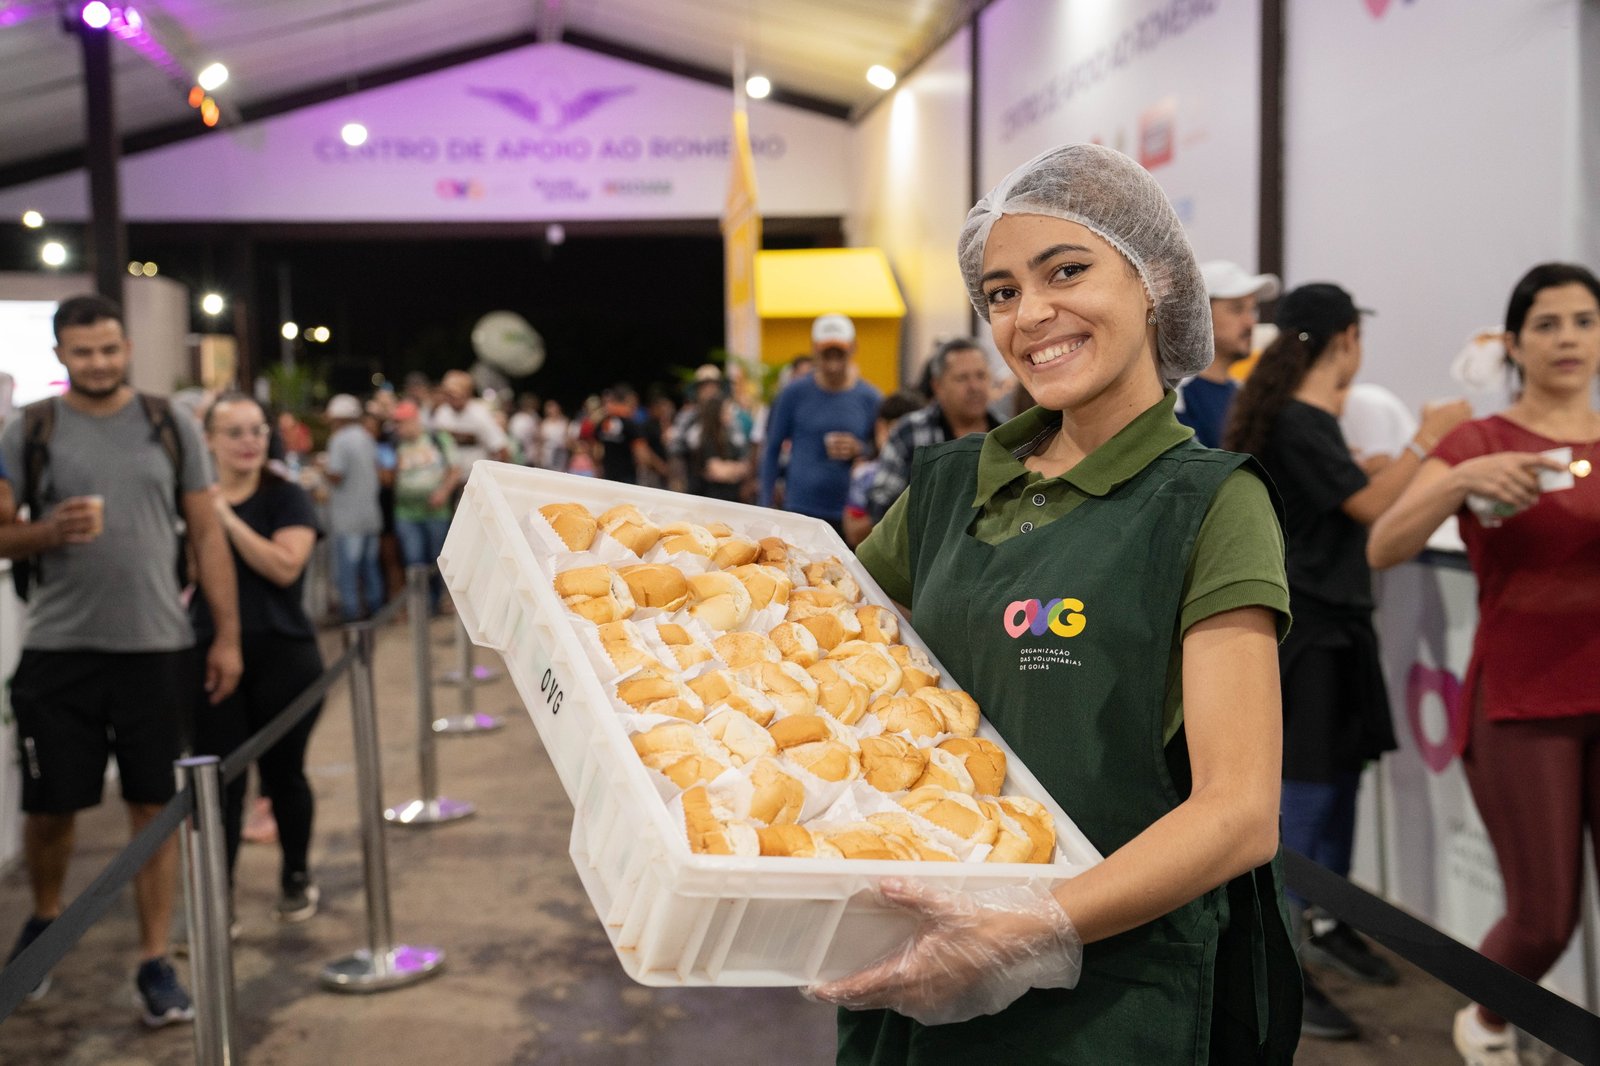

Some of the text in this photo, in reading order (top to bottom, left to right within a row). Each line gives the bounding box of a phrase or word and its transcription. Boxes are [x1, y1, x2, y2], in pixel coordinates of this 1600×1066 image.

[313, 136, 786, 163] CENTRO DE APOIO AO ROMERO
[1003, 598, 1087, 639] OVG
[1020, 648, 1070, 656] ORGANIZAÇÃO
[1028, 662, 1050, 670] GOIÁS
[1033, 655, 1082, 667] VOLUNTÁRIAS
